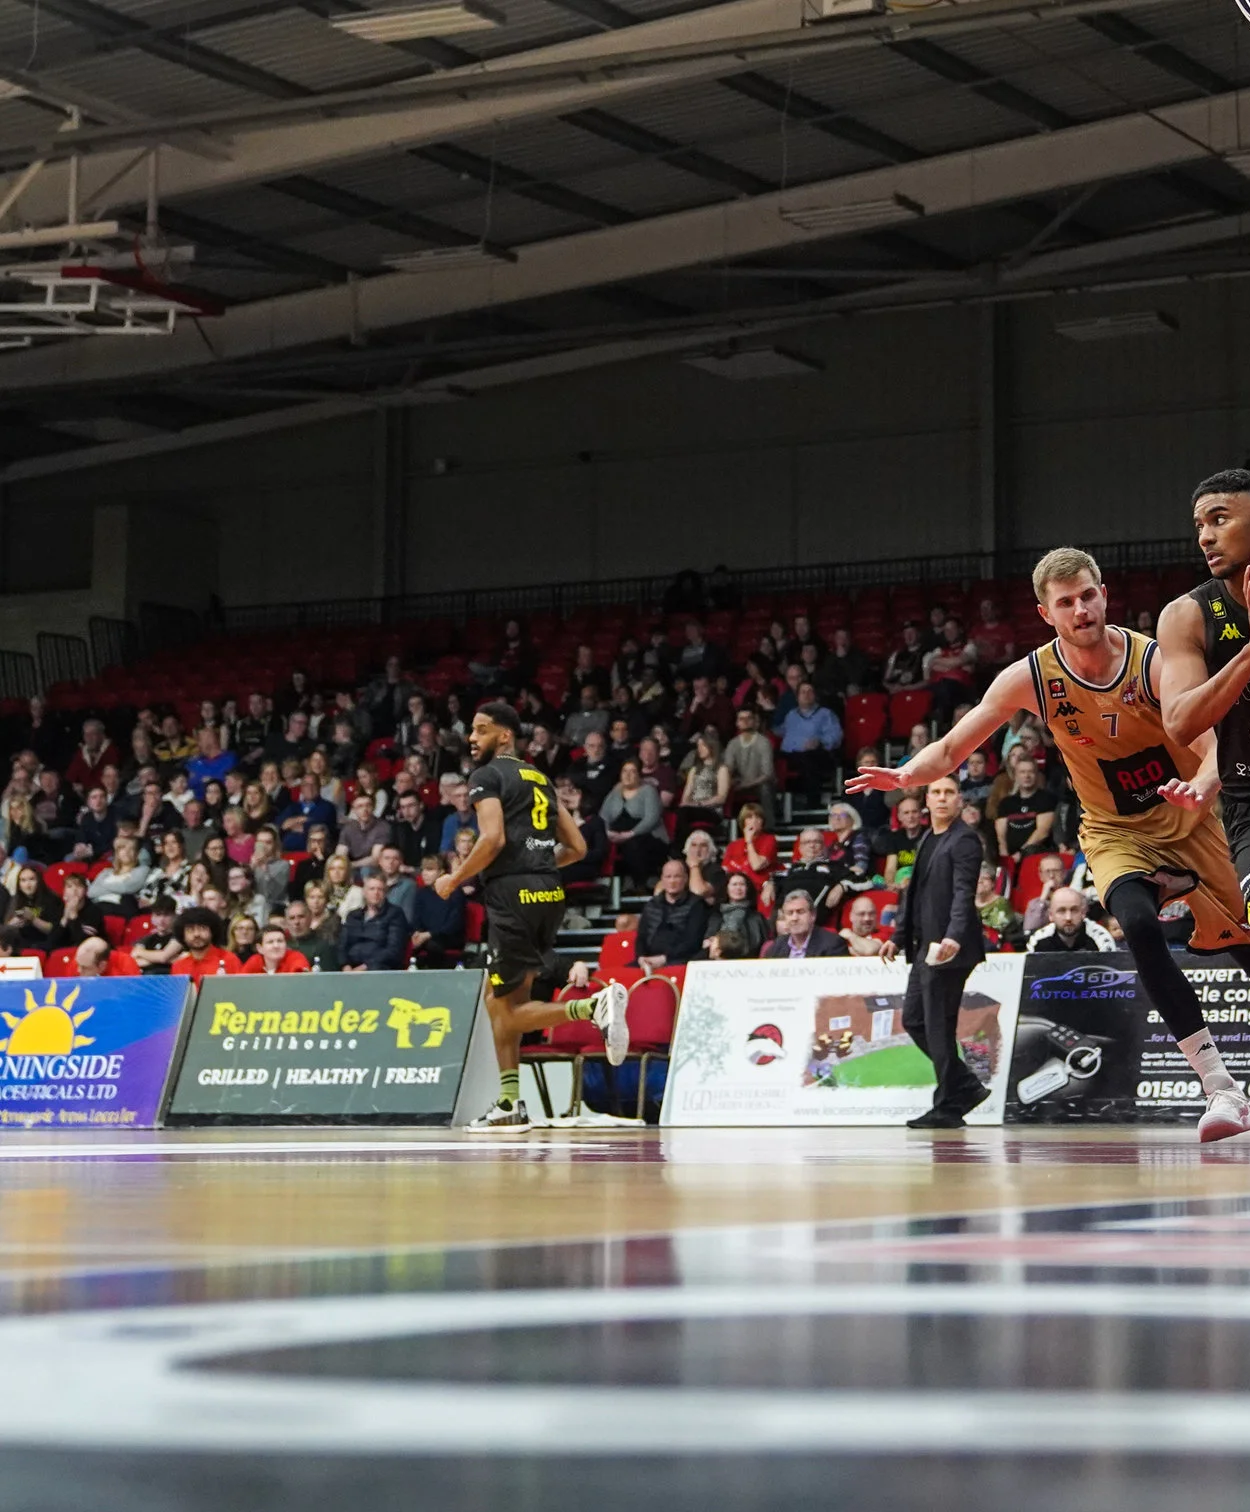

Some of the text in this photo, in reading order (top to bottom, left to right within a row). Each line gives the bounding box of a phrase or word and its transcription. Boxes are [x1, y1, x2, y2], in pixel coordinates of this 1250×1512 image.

[1101, 712, 1119, 738] 7
[531, 786, 549, 831] 8
[1073, 972, 1114, 984] 360
[210, 1001, 379, 1035] Fernandez
[222, 1035, 358, 1051] Grillhouse
[1221, 1032, 1238, 1042] and
[198, 1069, 268, 1086] GRILLED
[285, 1068, 369, 1085] HEALTHY
[384, 1067, 441, 1084] FRESH
[87, 1084, 118, 1100] LTD
[1137, 1080, 1202, 1098] 01509
